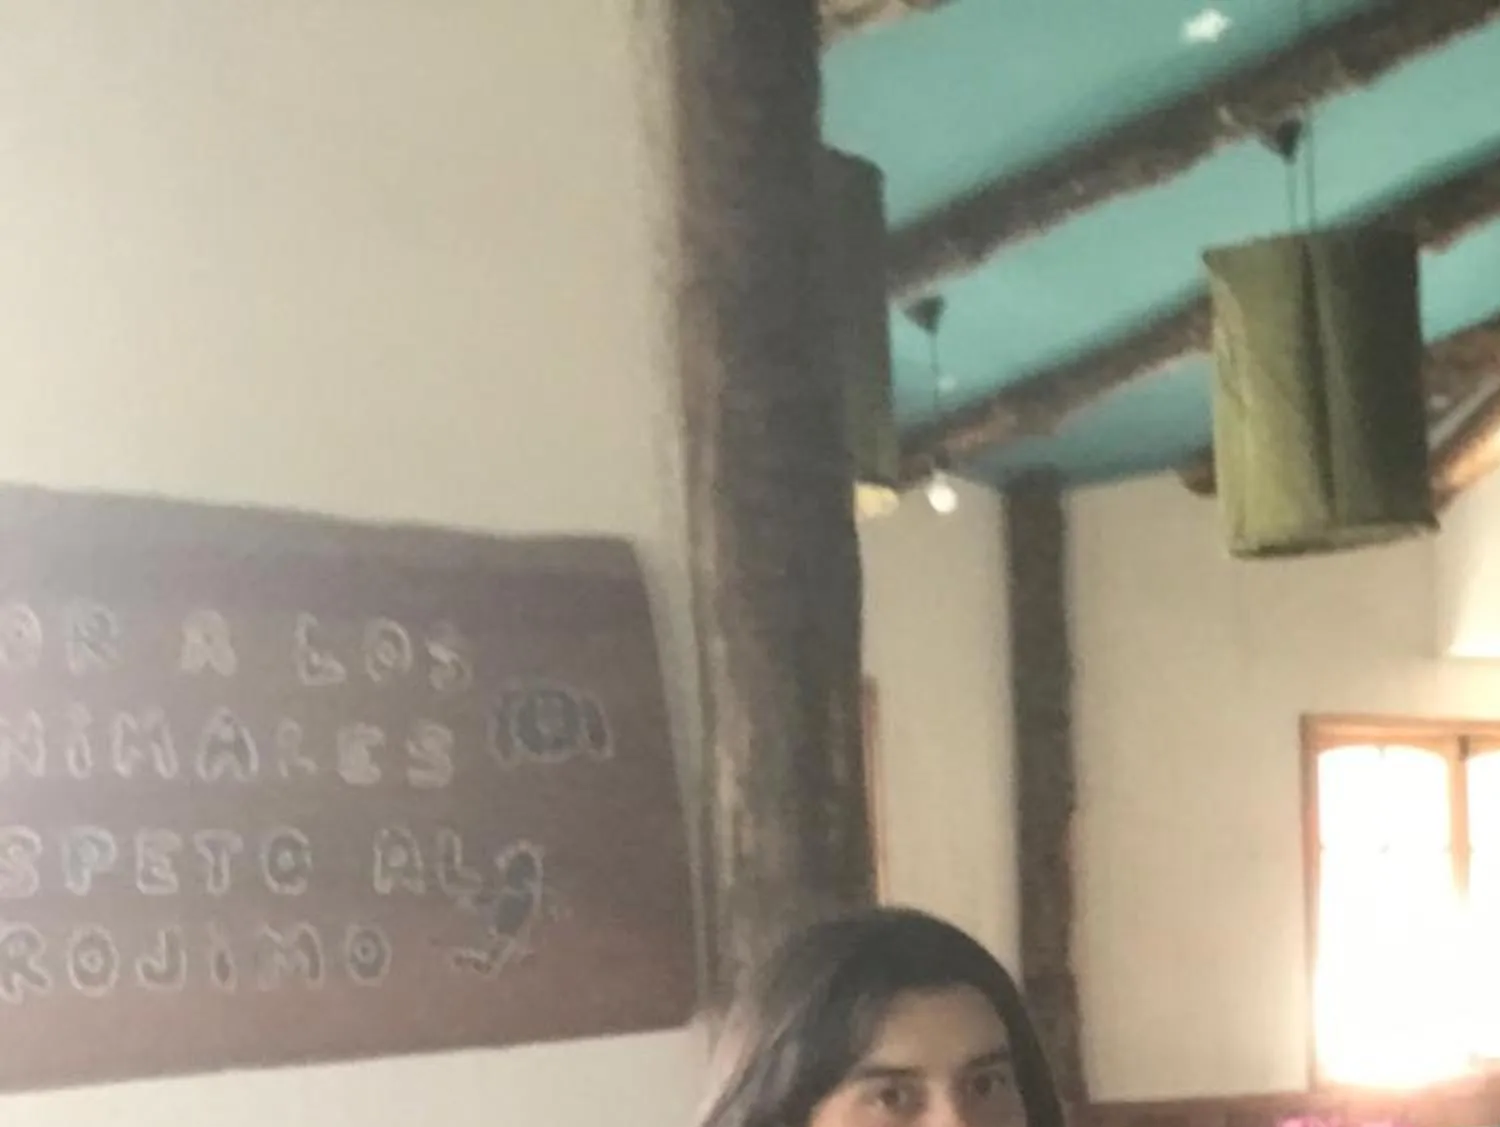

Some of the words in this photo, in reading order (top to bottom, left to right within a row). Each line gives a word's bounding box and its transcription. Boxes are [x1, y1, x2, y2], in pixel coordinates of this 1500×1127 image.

[294, 608, 475, 692] LOS
[0, 702, 456, 790] NIMALES
[373, 824, 483, 899] AL
[0, 920, 393, 1004] ROJIMO
